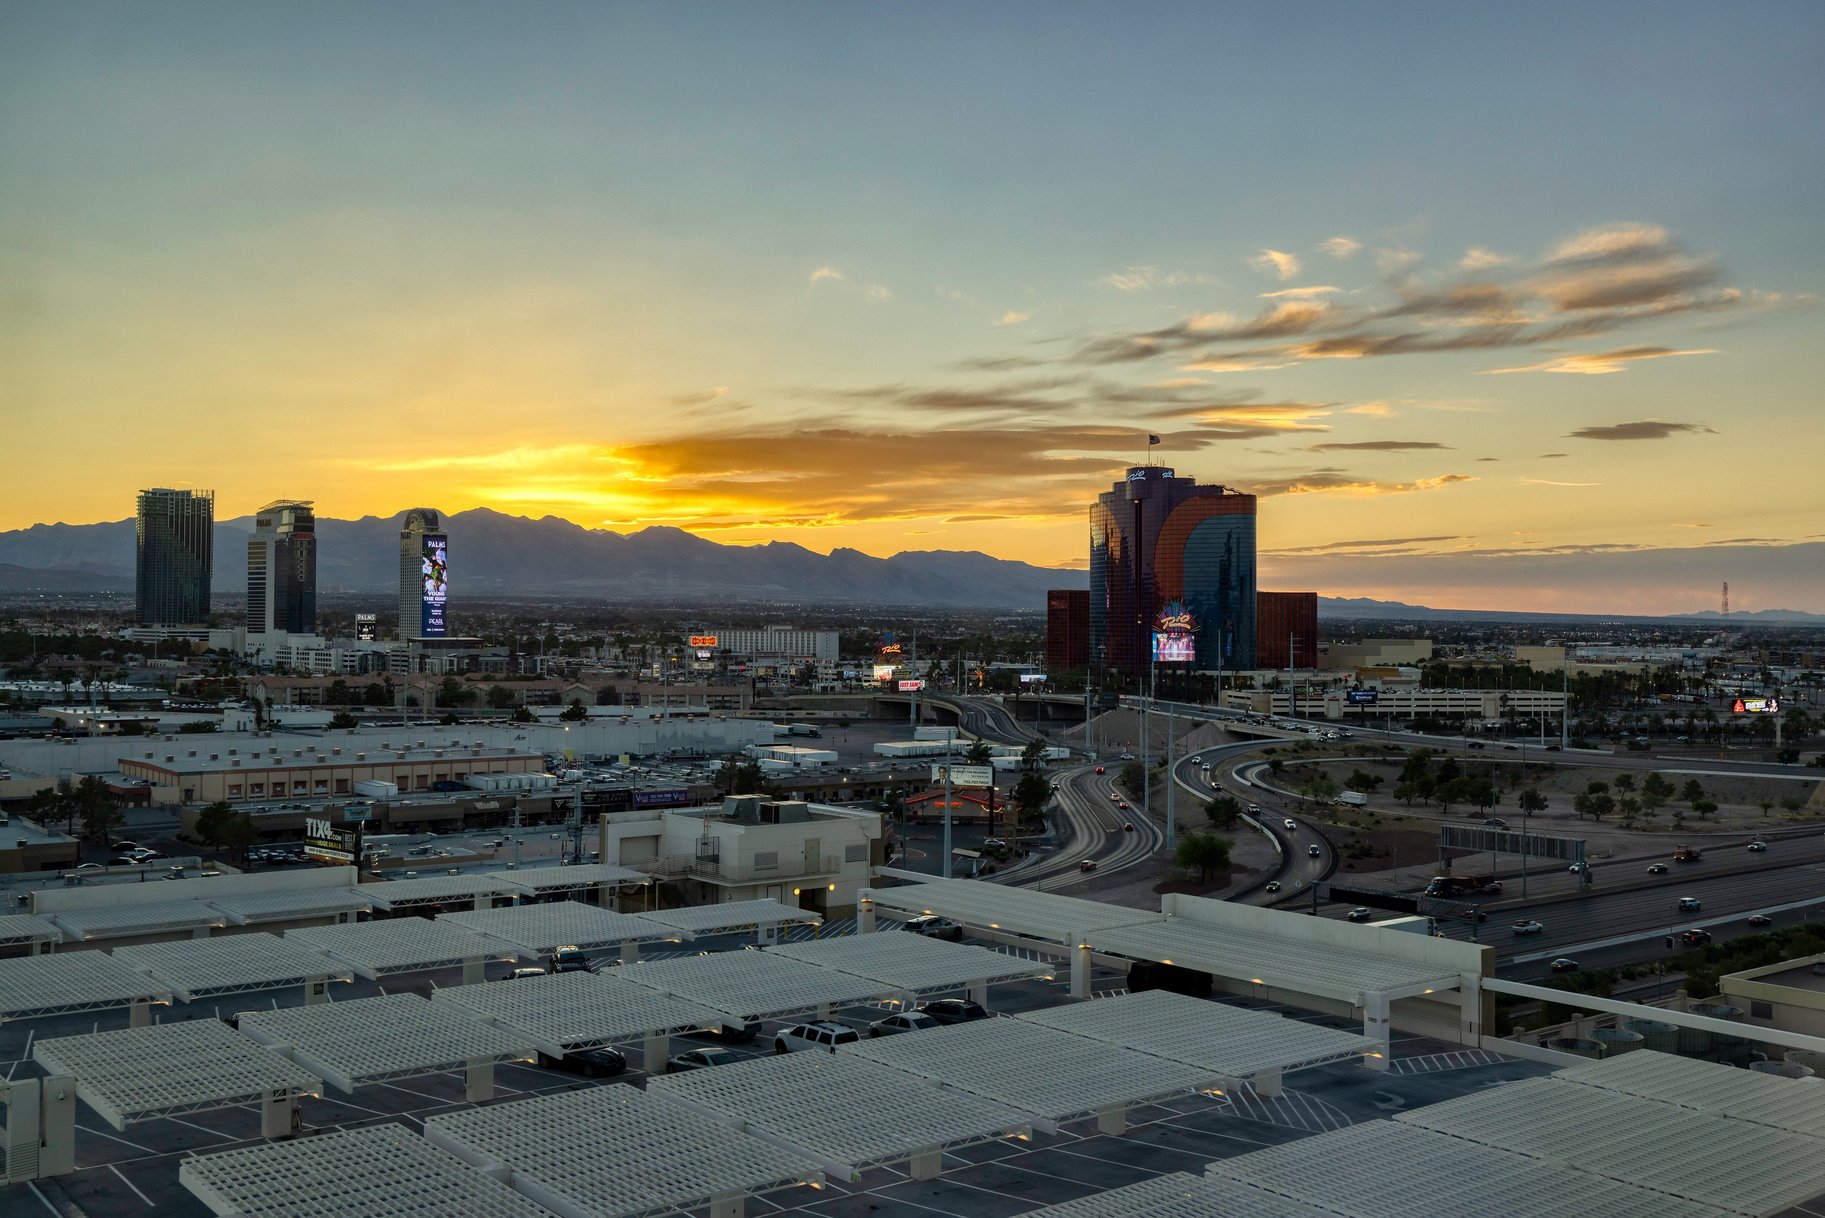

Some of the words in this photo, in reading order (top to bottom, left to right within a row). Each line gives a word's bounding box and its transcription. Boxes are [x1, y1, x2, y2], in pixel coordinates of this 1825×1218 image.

[1127, 470, 1146, 482] Rio
[1160, 613, 1191, 630] Rio
[881, 643, 901, 654] Rio
